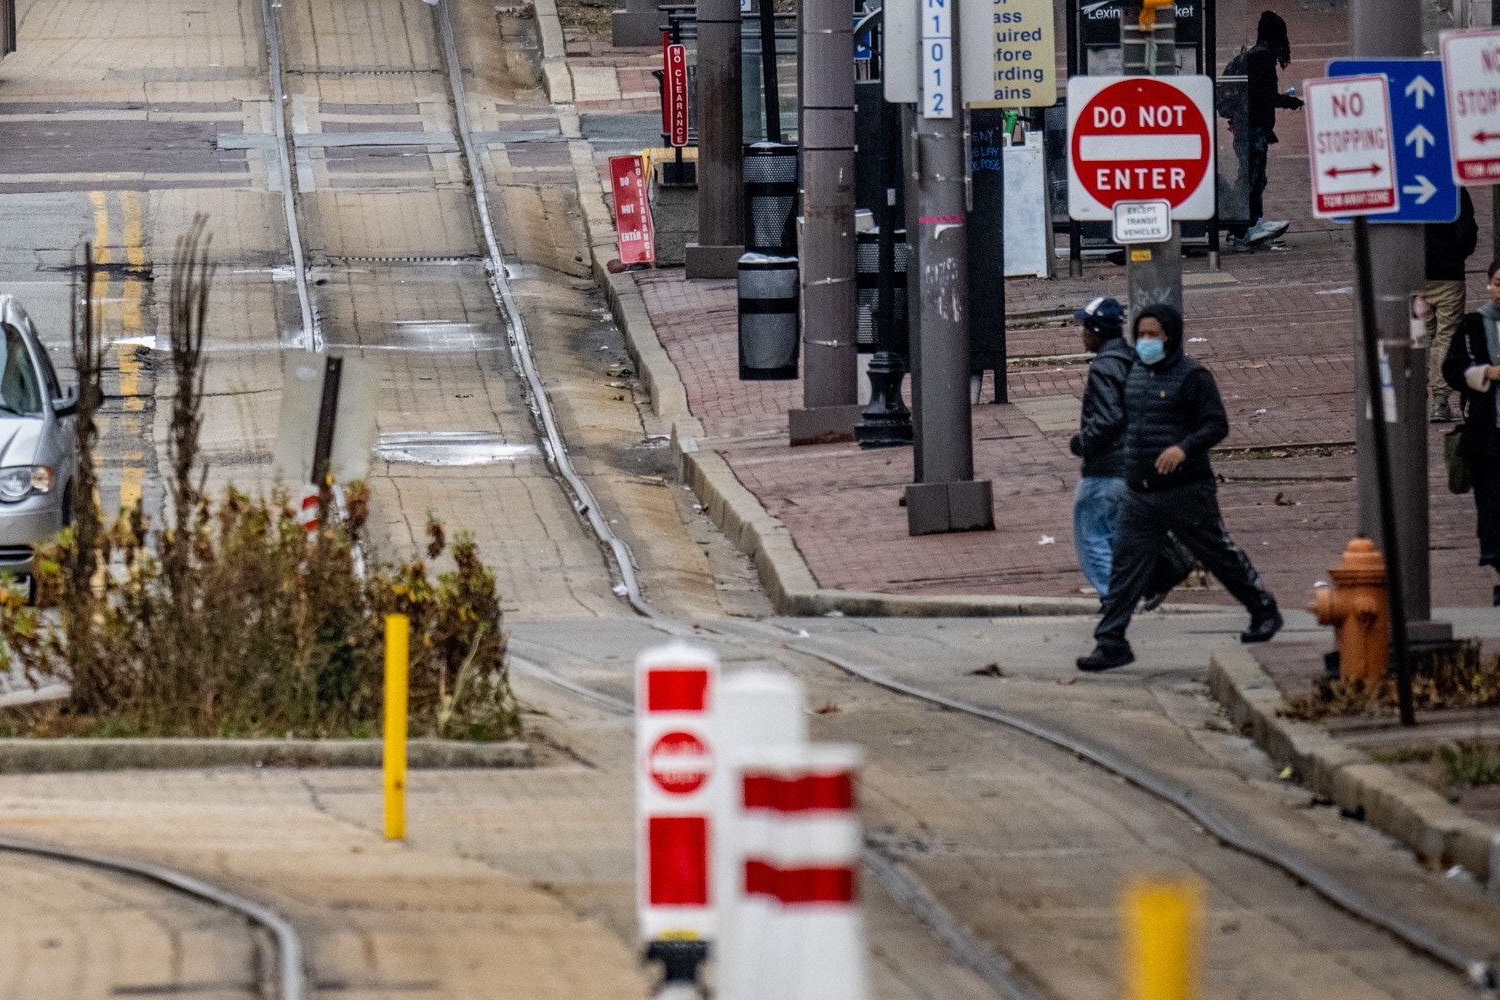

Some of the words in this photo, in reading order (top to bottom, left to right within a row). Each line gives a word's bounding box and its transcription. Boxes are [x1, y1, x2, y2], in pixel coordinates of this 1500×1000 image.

[994, 12, 1022, 24] ass
[1088, 6, 1120, 20] Lexin
[1175, 5, 1195, 18] ket
[996, 27, 1042, 42] uired
[674, 48, 681, 64] NO
[995, 48, 1032, 61] fore
[994, 67, 1044, 83] rding
[994, 86, 1031, 100] ains
[675, 69, 683, 143] CLEARANCE
[1332, 93, 1364, 118] NO
[1093, 106, 1126, 128] DO
[1139, 105, 1186, 127] NOT
[972, 130, 994, 144] ENY
[1317, 127, 1385, 154] STOPPING
[634, 158, 641, 176] NO
[620, 177, 630, 187] DO
[1097, 168, 1186, 190] ENTER
[621, 204, 635, 215] NOT
[1127, 206, 1156, 214] EXCEPT
[637, 178, 651, 259] CLEARANCE
[621, 231, 642, 243] ENTER
